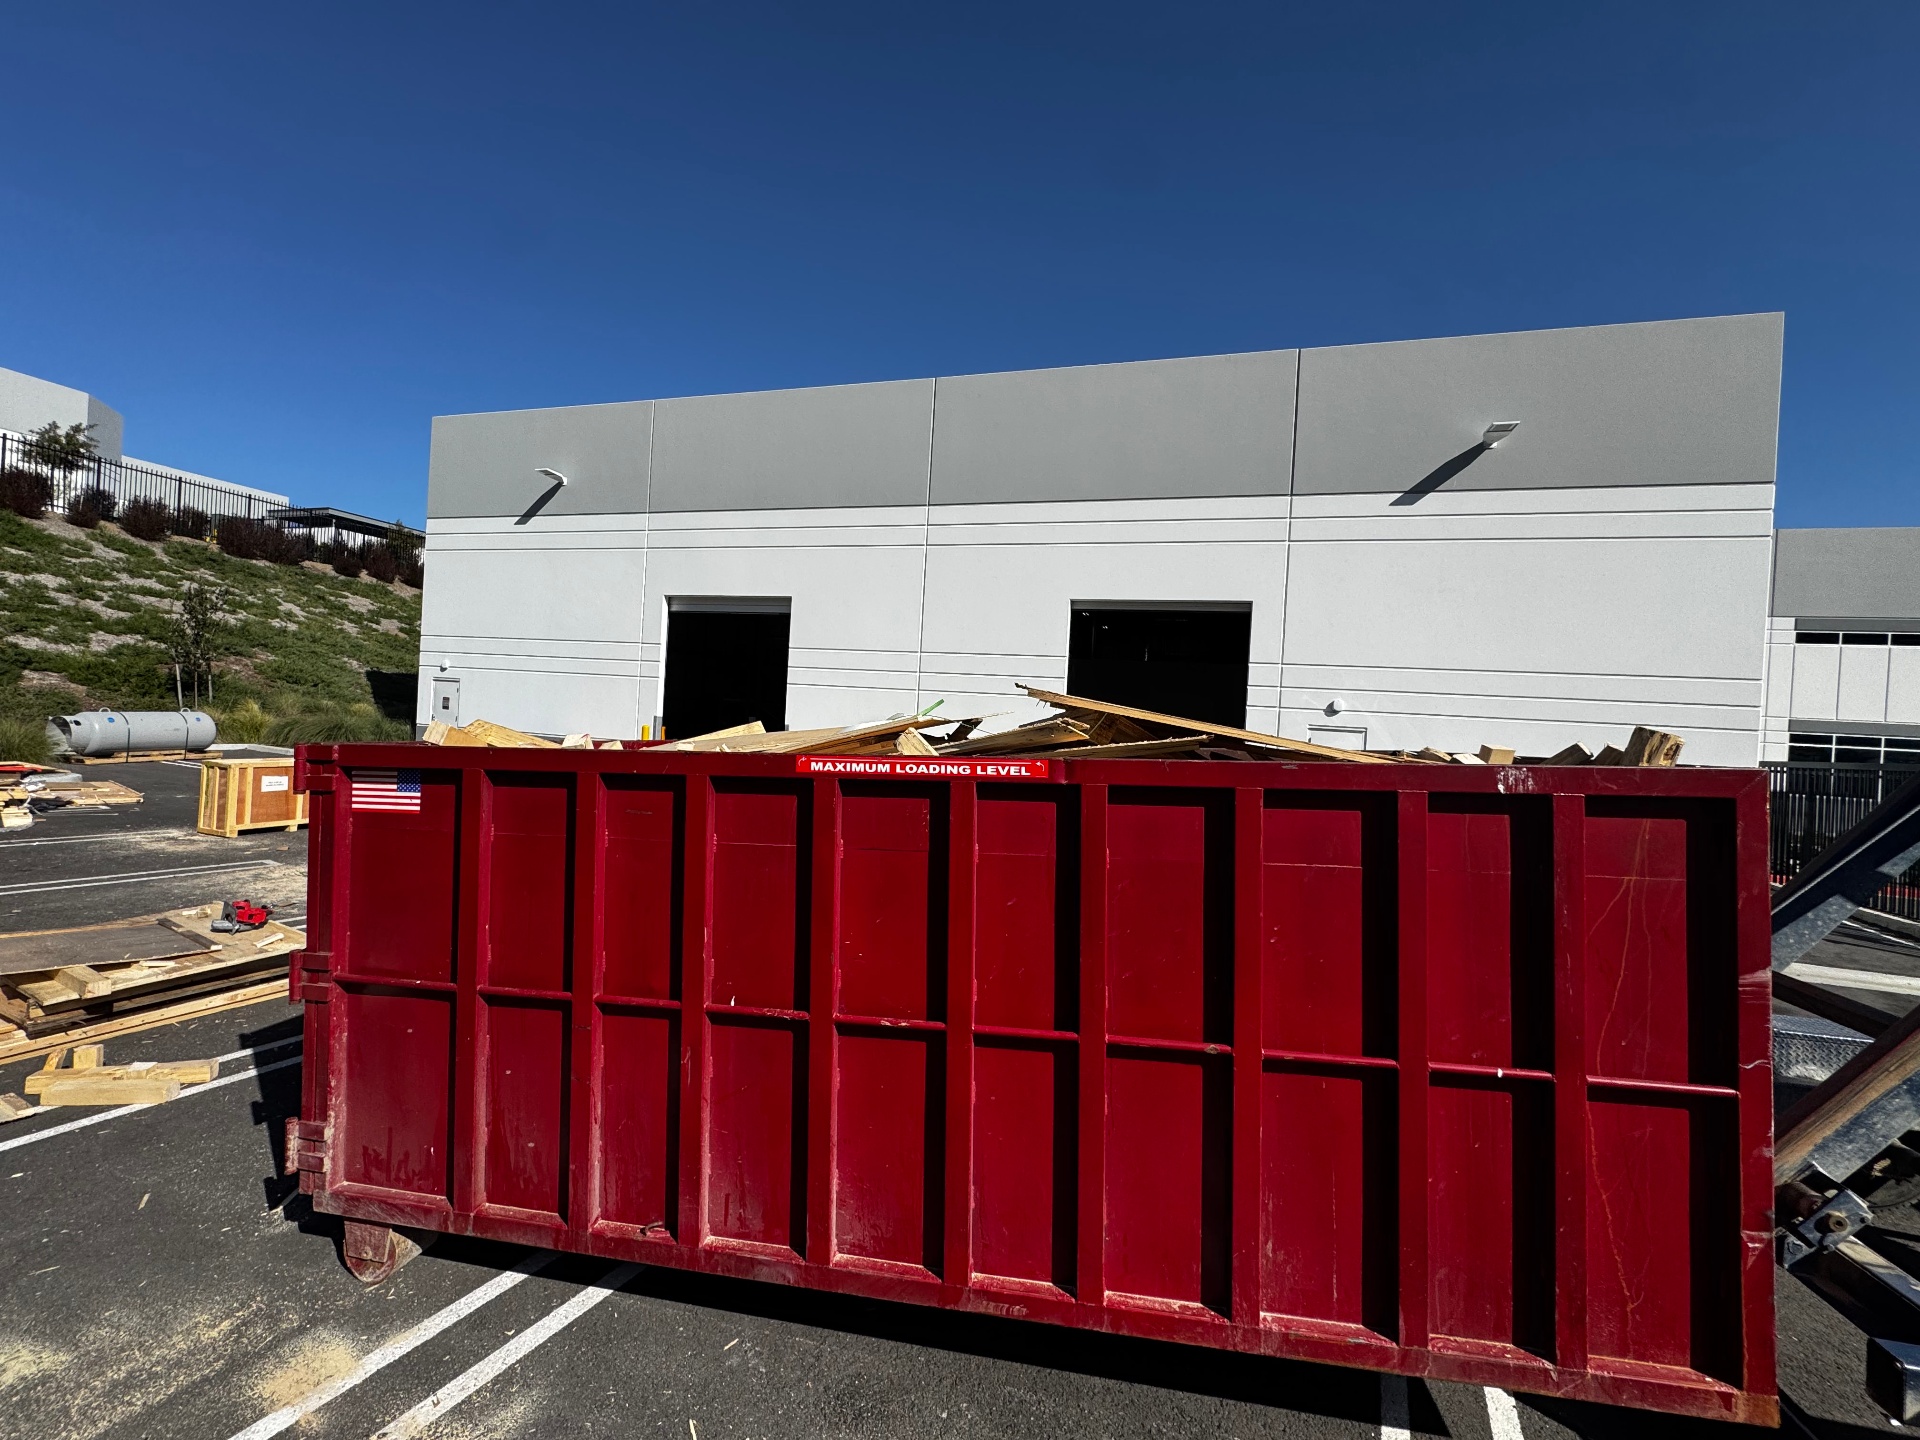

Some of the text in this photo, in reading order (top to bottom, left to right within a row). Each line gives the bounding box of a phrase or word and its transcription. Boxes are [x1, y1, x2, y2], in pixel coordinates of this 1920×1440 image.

[810, 761, 1031, 776] MAXIMUM LOADING LEVEL
